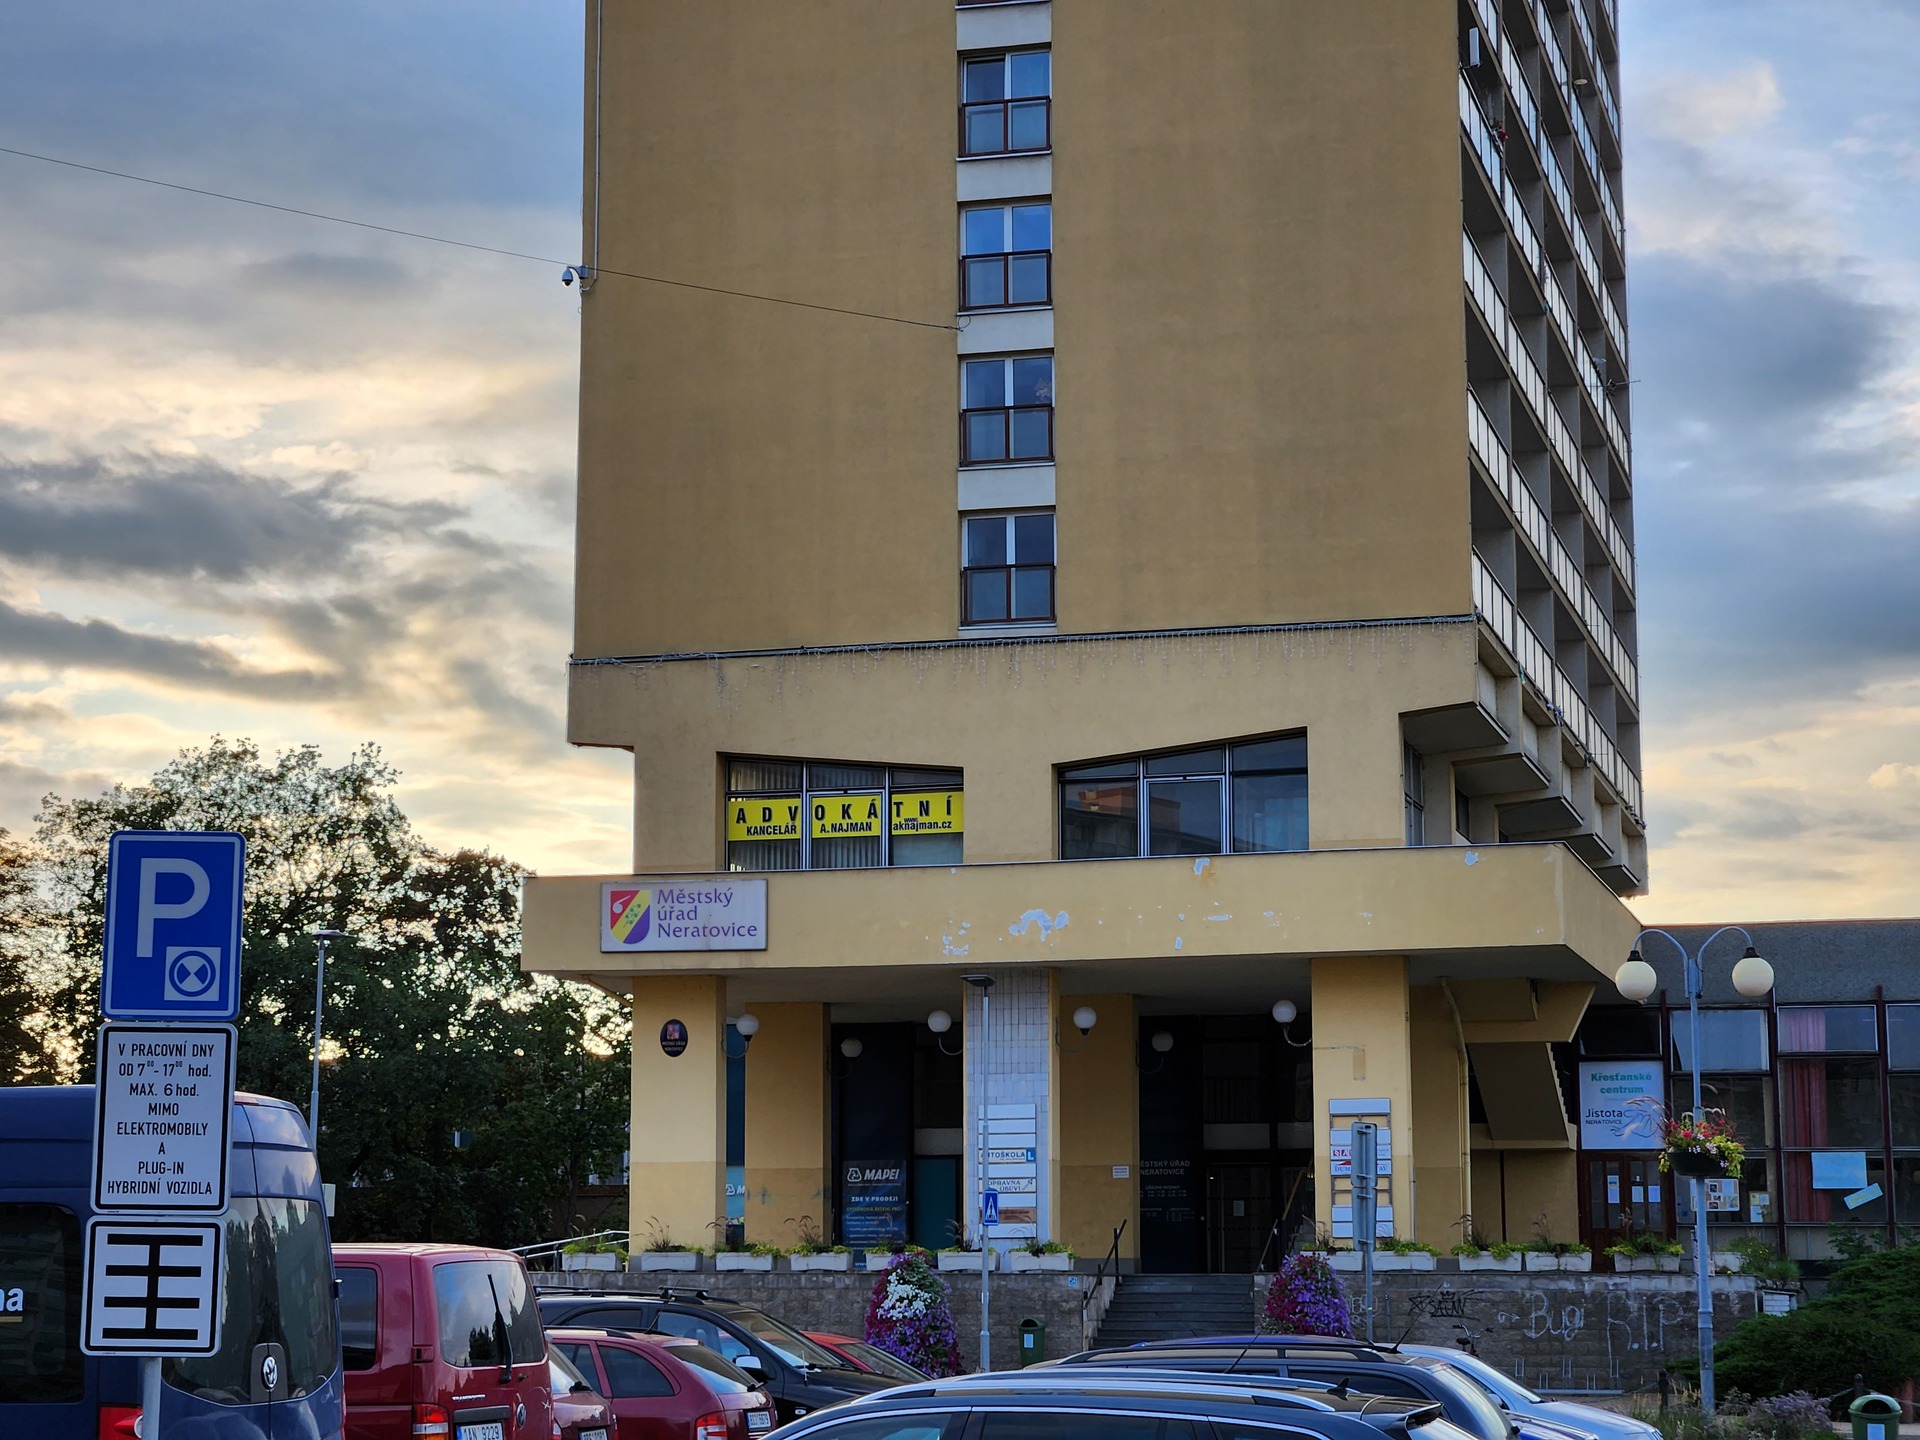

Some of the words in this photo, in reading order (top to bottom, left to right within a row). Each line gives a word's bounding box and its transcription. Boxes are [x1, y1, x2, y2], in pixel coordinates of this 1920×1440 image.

[746, 821, 797, 836] KANCELÁŘ
[893, 819, 952, 832] aknajman.cz
[657, 886, 733, 907] Městský
[136, 857, 211, 958] P
[657, 905, 698, 921] úřad
[657, 922, 758, 938] Neratovice
[118, 1043, 126, 1056] V
[131, 1041, 188, 1057] PRACOVNÍ
[192, 1044, 215, 1057] DNY
[118, 1063, 134, 1076] OD
[188, 1065, 212, 1077] hod.
[1591, 1072, 1652, 1082] Křesťanské
[129, 1083, 157, 1096] MAX.
[164, 1083, 173, 1096] 6
[175, 1084, 199, 1097] hod.
[1600, 1085, 1644, 1094] centrum
[148, 1103, 179, 1116] MIMO
[1585, 1108, 1623, 1118] Jistota
[117, 1122, 208, 1136] ELEKTROMOBILY
[158, 1142, 166, 1155] A
[138, 1161, 184, 1174] PLUG-IN
[864, 1169, 900, 1180] MAPEI
[107, 1177, 162, 1194] HYBRIDNÍ
[166, 1181, 212, 1195] VOZIDLA
[481, 1425, 500, 1440] 9229
